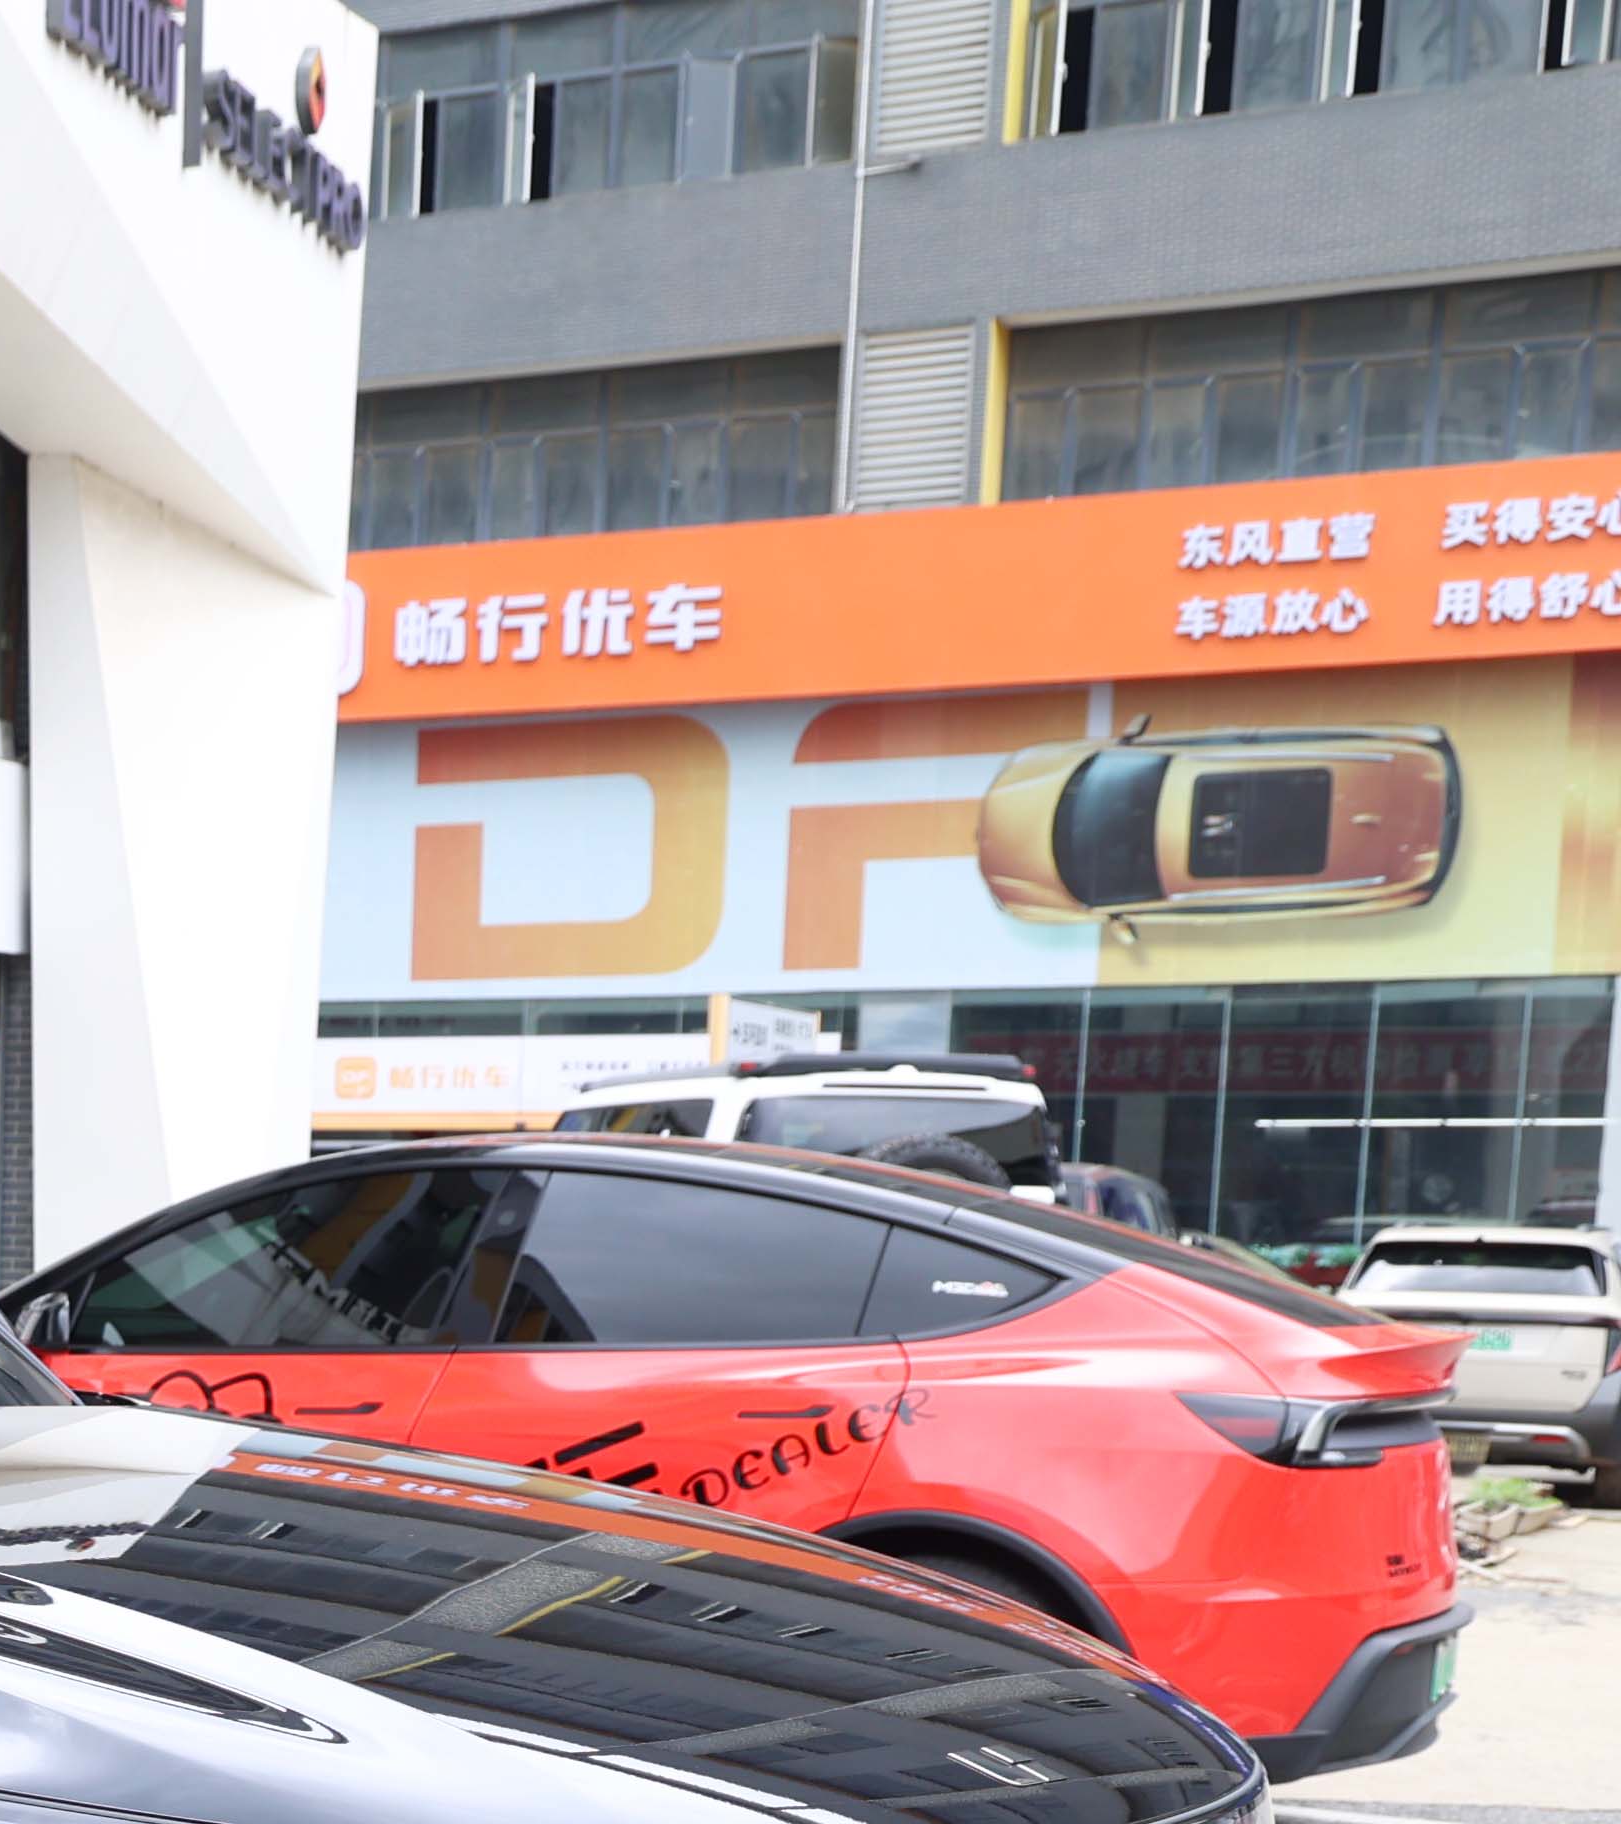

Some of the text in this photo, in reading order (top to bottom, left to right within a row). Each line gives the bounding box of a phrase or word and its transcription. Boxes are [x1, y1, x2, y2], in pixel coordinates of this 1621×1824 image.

[1178, 513, 1376, 569] 东风直营
[394, 583, 723, 667] 畅行优车
[1175, 588, 1369, 640] 车源放心
